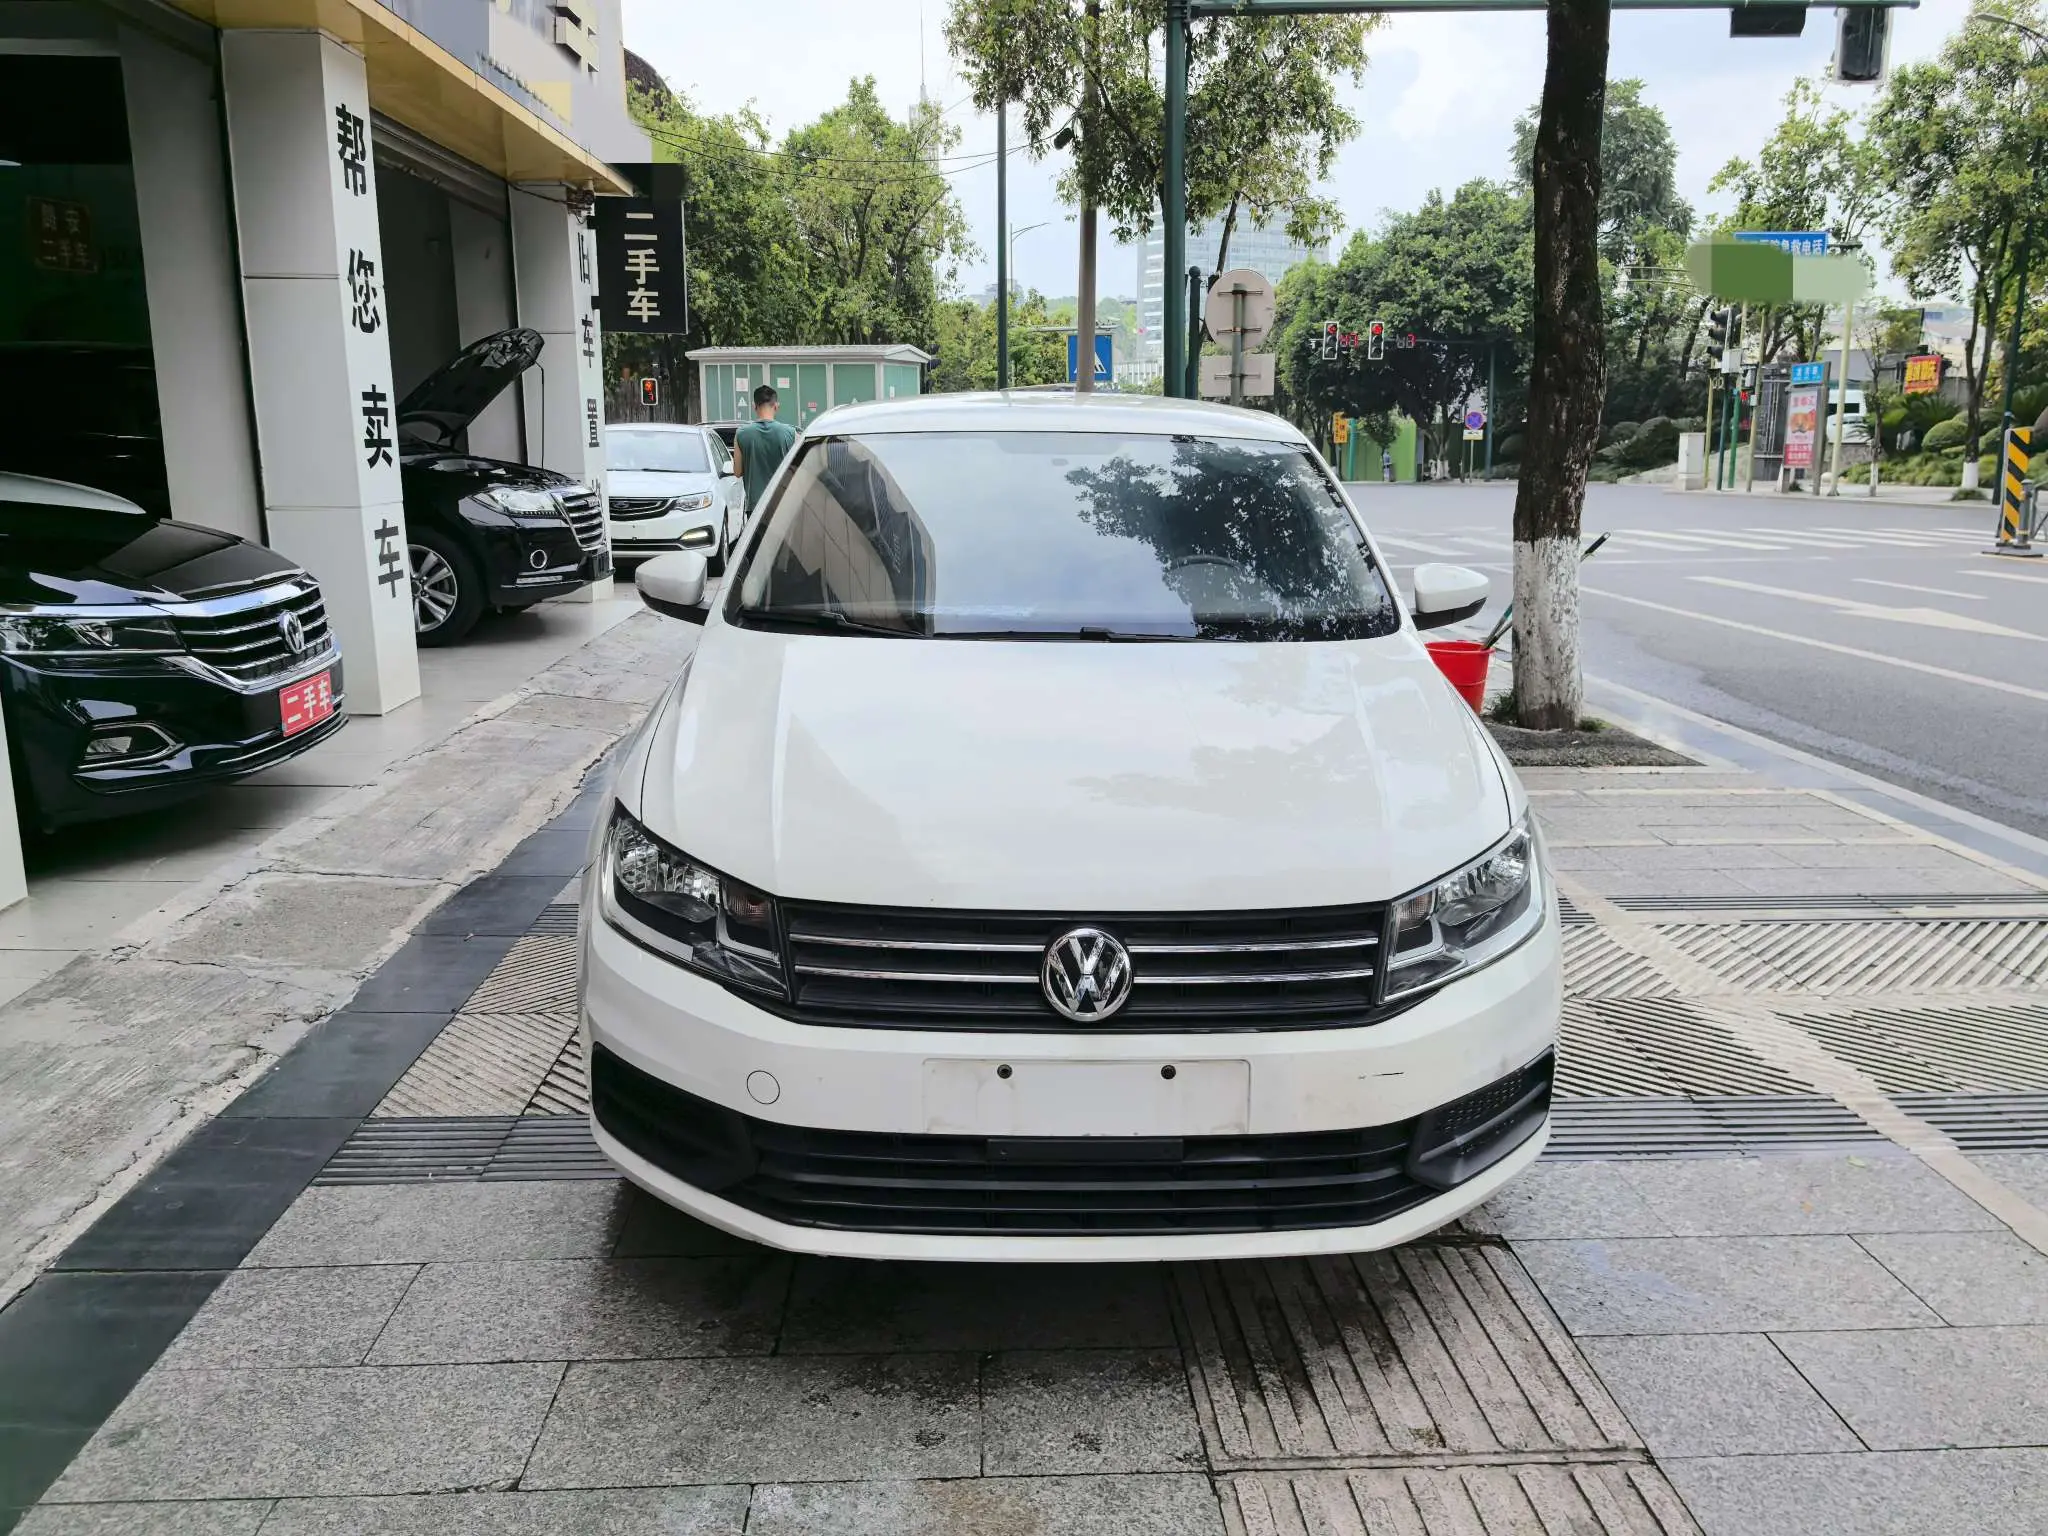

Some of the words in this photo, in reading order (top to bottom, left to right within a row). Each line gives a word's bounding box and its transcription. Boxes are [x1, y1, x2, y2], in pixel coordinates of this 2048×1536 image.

[624, 211, 661, 323] 二手车
[336, 103, 404, 598] 帮您卖车
[286, 679, 331, 724] 二手车
